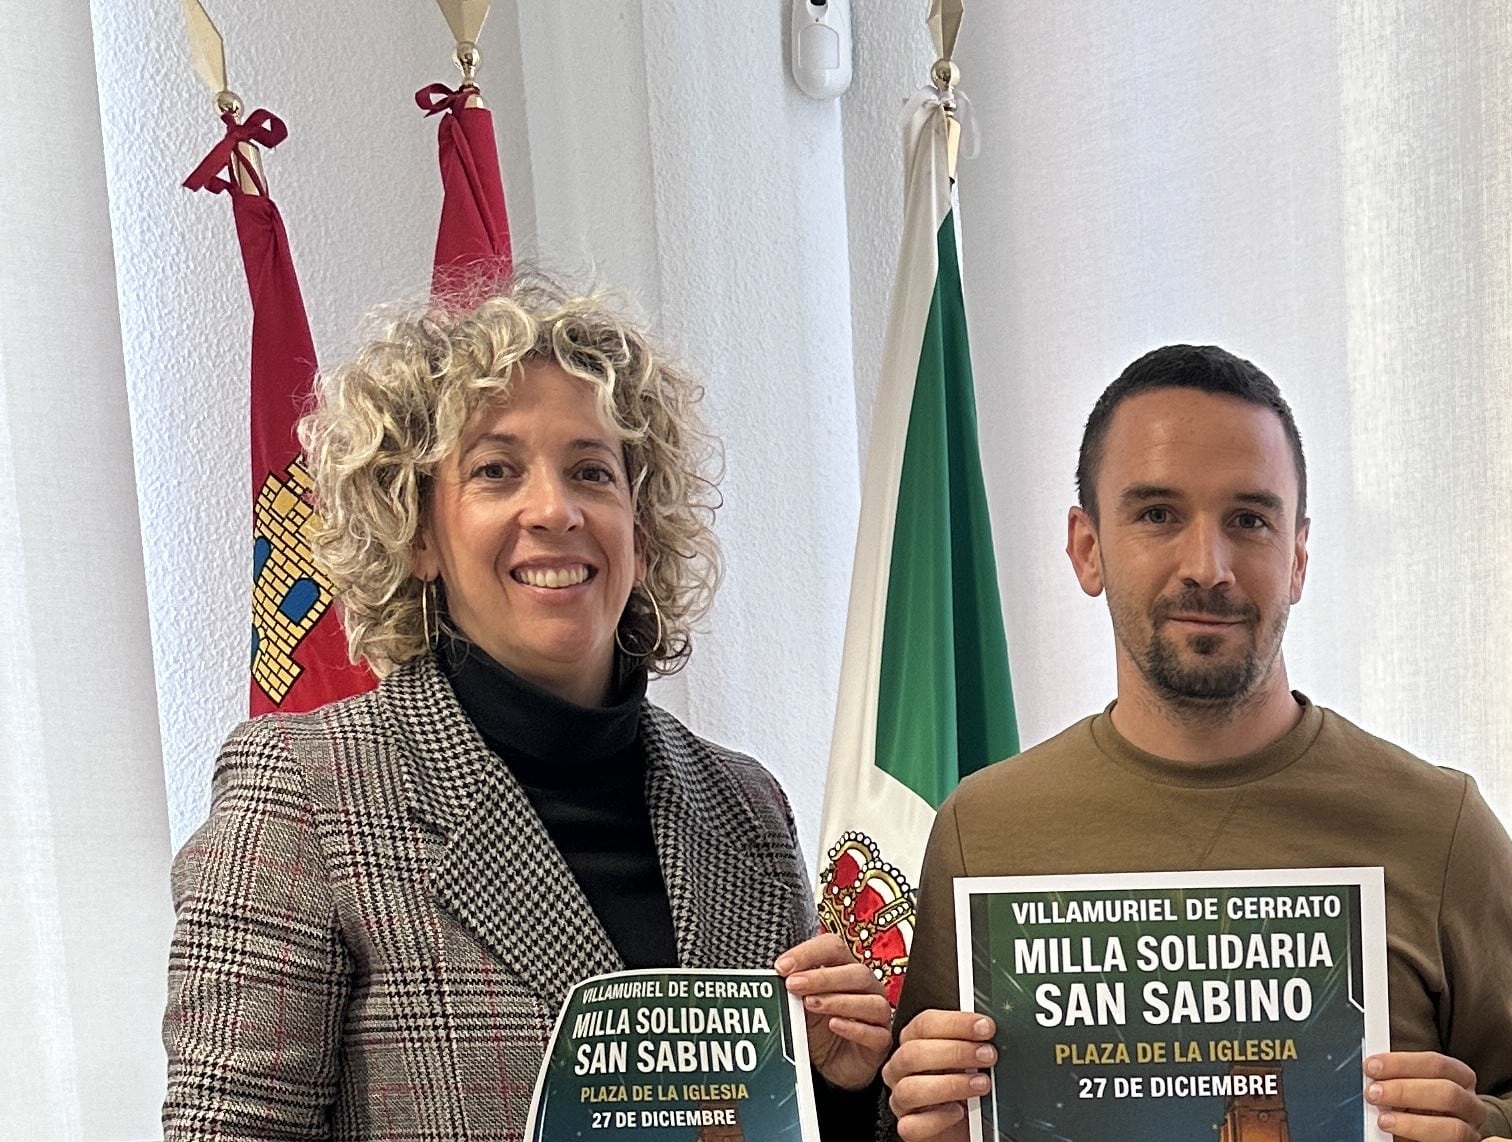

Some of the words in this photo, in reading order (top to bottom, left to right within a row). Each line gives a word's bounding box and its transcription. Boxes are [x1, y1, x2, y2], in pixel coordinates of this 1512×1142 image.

[1012, 898, 1177, 925] VILLAMURIEL
[1186, 897, 1218, 920] DE
[1228, 895, 1341, 920] CERRATO
[1014, 936, 1127, 974] MILLA
[1136, 932, 1334, 972] SOLIDARIA
[583, 981, 663, 1004] VILLAMURIEL
[668, 981, 689, 998] DE
[694, 981, 773, 998] CERRATO
[1035, 981, 1125, 1027] SAN
[1142, 977, 1312, 1025] SABINO
[572, 1009, 630, 1039] MILLA
[635, 1007, 770, 1035] SOLIDARIA
[574, 1042, 627, 1075] SAN
[636, 1040, 758, 1073] SABINO
[1055, 1043, 1130, 1065] PLAZA
[1137, 1042, 1166, 1063] DE
[1174, 1041, 1201, 1063] LA
[1210, 1039, 1298, 1062] IGLESIA
[581, 1085, 628, 1103] PLAZA
[632, 1085, 653, 1101] DE
[658, 1084, 679, 1101] LA
[683, 1083, 749, 1100] IGLESIA
[1079, 1078, 1106, 1099] 27
[1114, 1077, 1144, 1098] DE
[1150, 1075, 1278, 1097] DICIEMBRE
[592, 1112, 615, 1129] 27
[616, 1111, 637, 1128] DE
[641, 1109, 736, 1127] DICIEMBRE
